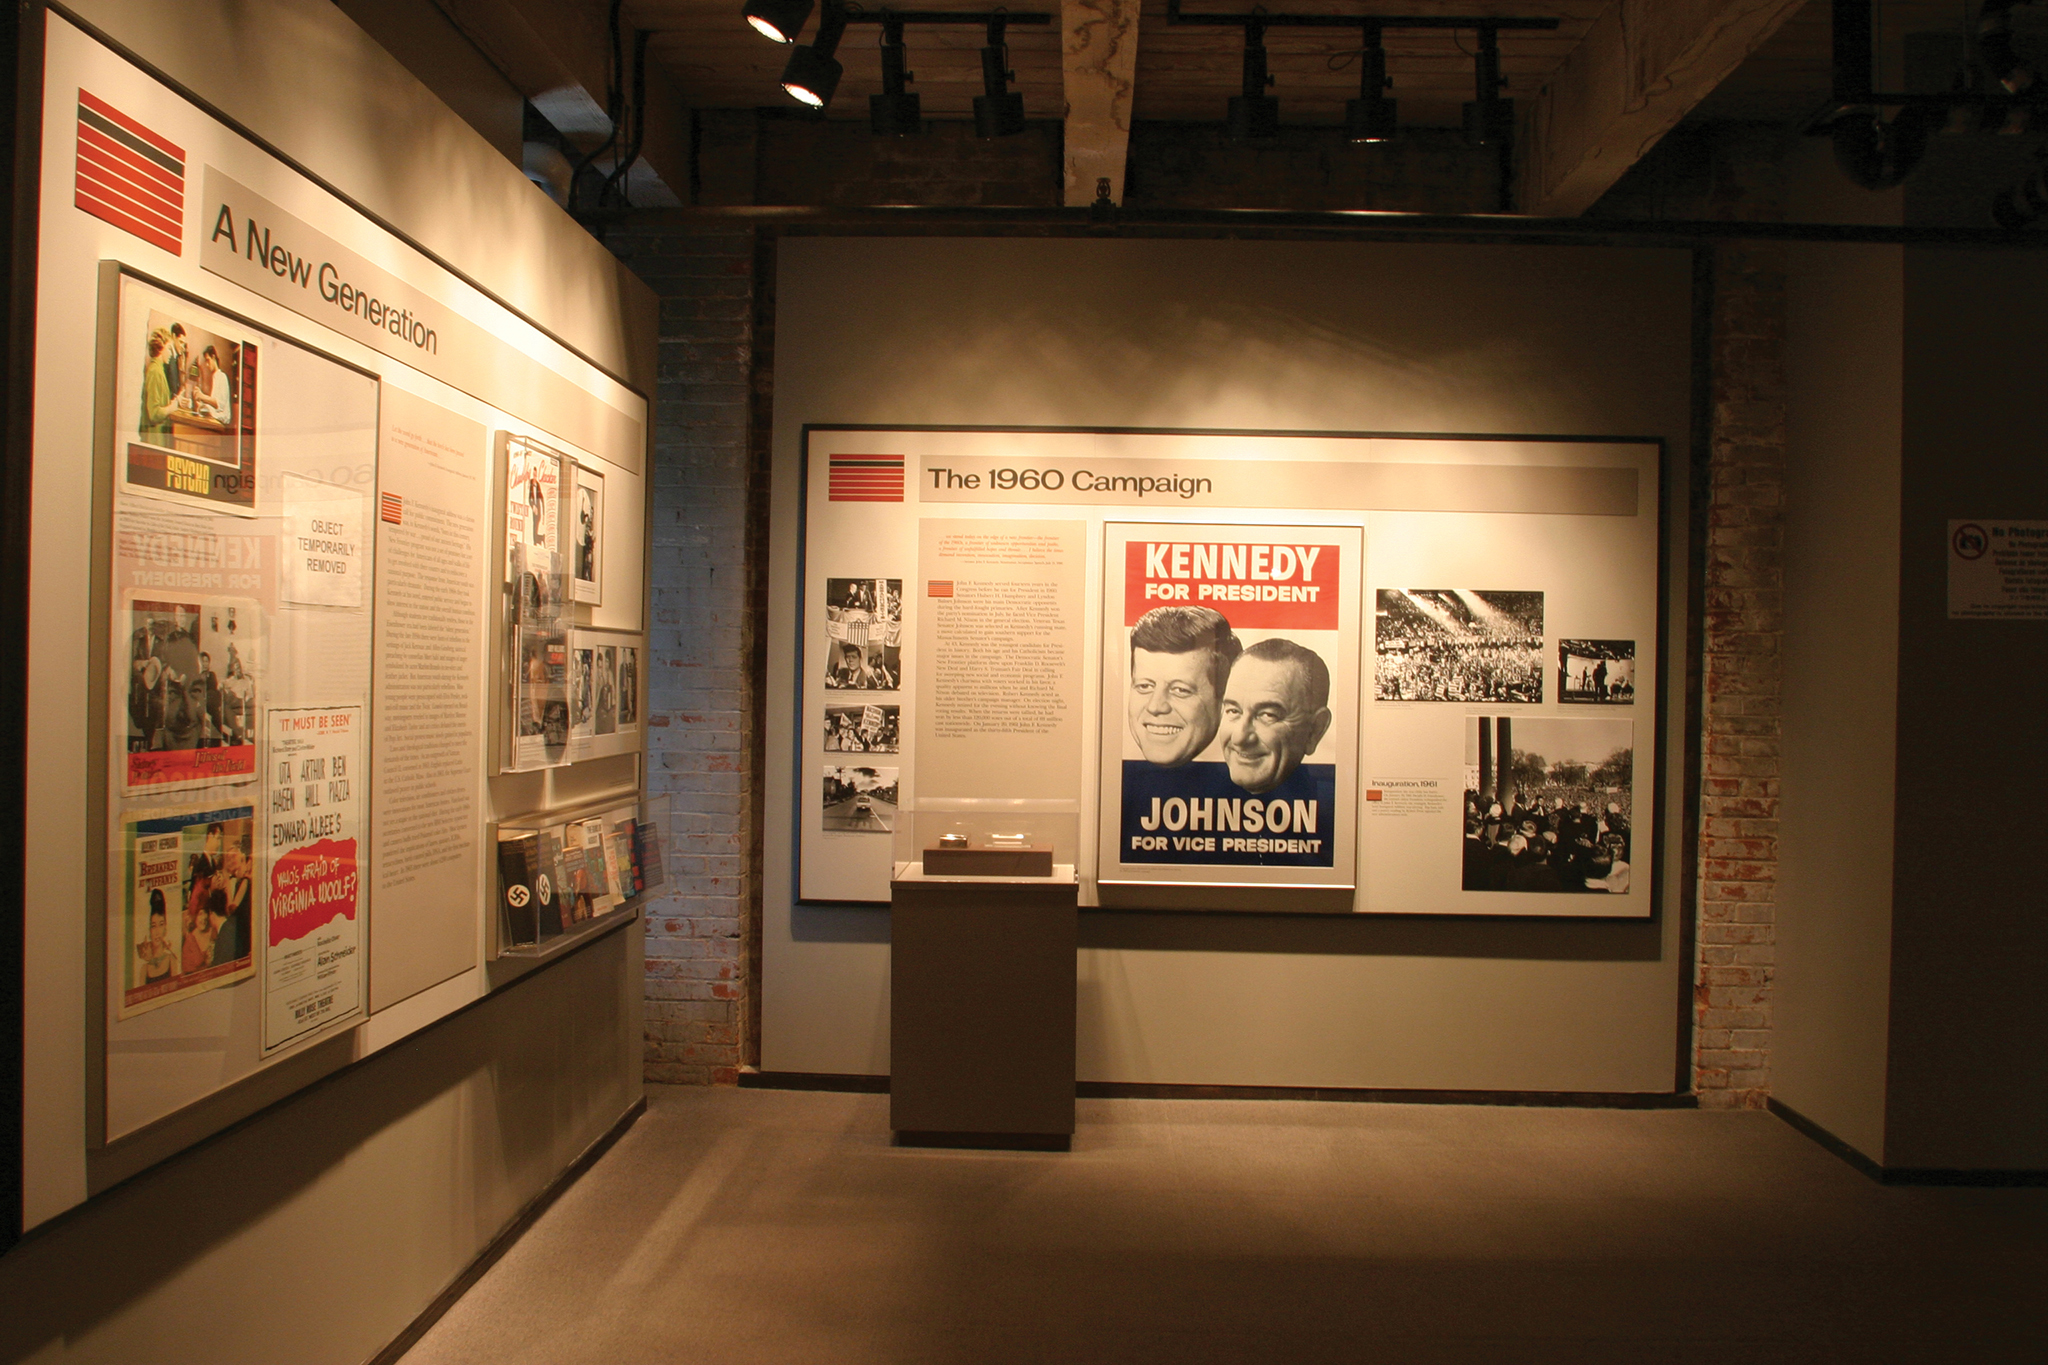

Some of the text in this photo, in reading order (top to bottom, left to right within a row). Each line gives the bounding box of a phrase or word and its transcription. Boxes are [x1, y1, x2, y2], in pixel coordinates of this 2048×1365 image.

[212, 203, 437, 355] A New Generation
[166, 455, 210, 495] PSYCHO
[927, 468, 1212, 499] The 1960 Campaign
[311, 519, 344, 536] OBJECT
[297, 537, 355, 556] TEMPORARILY
[307, 558, 347, 574] REMOVED
[1145, 543, 1321, 582] KENNEDY
[1145, 583, 1320, 602] FOR PRESIDENT
[293, 716, 316, 730] MUST
[319, 716, 328, 728] BE
[279, 755, 346, 785] UTA ARTHUR BEN
[1421, 780, 1438, 788] 1961
[329, 779, 350, 803] PIAZZA
[272, 812, 341, 847] EDWARD ALBEE'S
[1140, 797, 1318, 833] JOHNSON
[1131, 836, 1321, 853] FOR VICE PRESIDENT
[277, 855, 340, 889] WHO'S AFRAID OF
[272, 871, 357, 920] VIRGINIA WOOLF?
